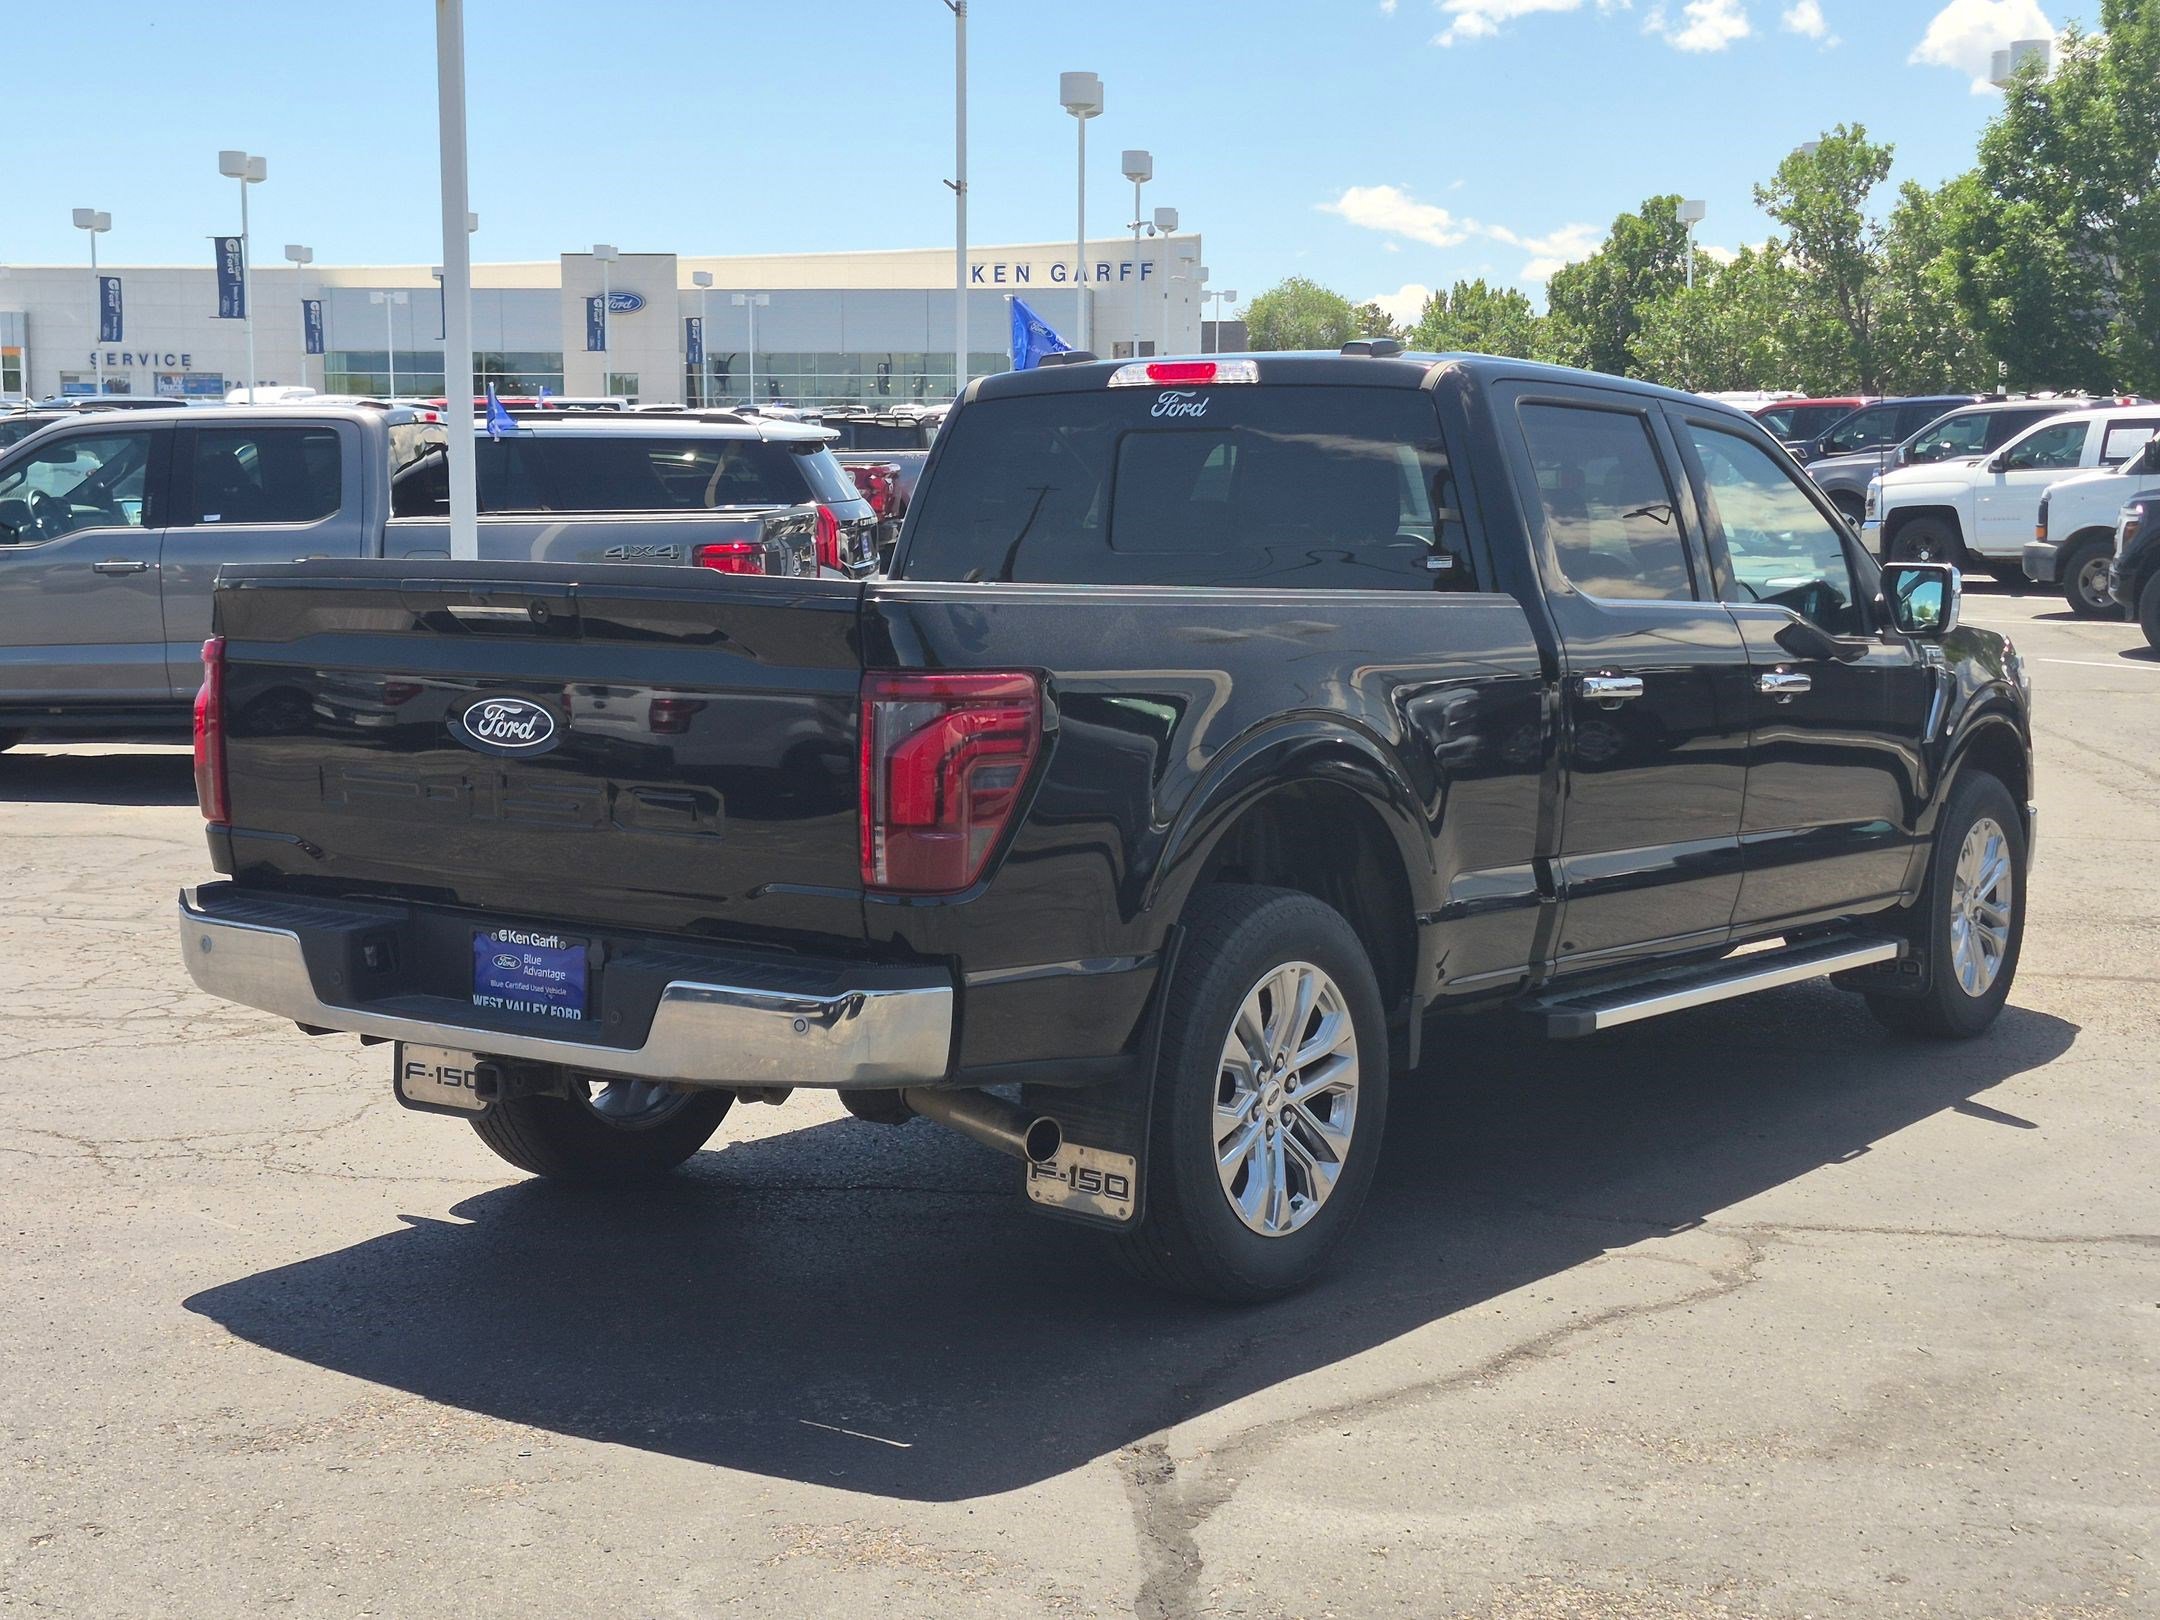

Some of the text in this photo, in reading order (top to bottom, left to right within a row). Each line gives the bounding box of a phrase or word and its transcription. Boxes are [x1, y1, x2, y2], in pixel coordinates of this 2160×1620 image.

[971, 265, 1030, 283] KEN
[90, 352, 191, 367] SERVICE
[1151, 390, 1209, 417] Ford
[604, 543, 681, 560] 4x4
[478, 704, 541, 740] Ford
[508, 930, 558, 949] Ken Garff
[497, 953, 542, 968] Ford Blue
[523, 966, 566, 981] Advantage
[490, 979, 567, 996] Blue Certified Used Vehicle
[473, 995, 503, 1008] WEST
[551, 1006, 581, 1020] FORD
[1031, 1162, 1129, 1201] F-150
